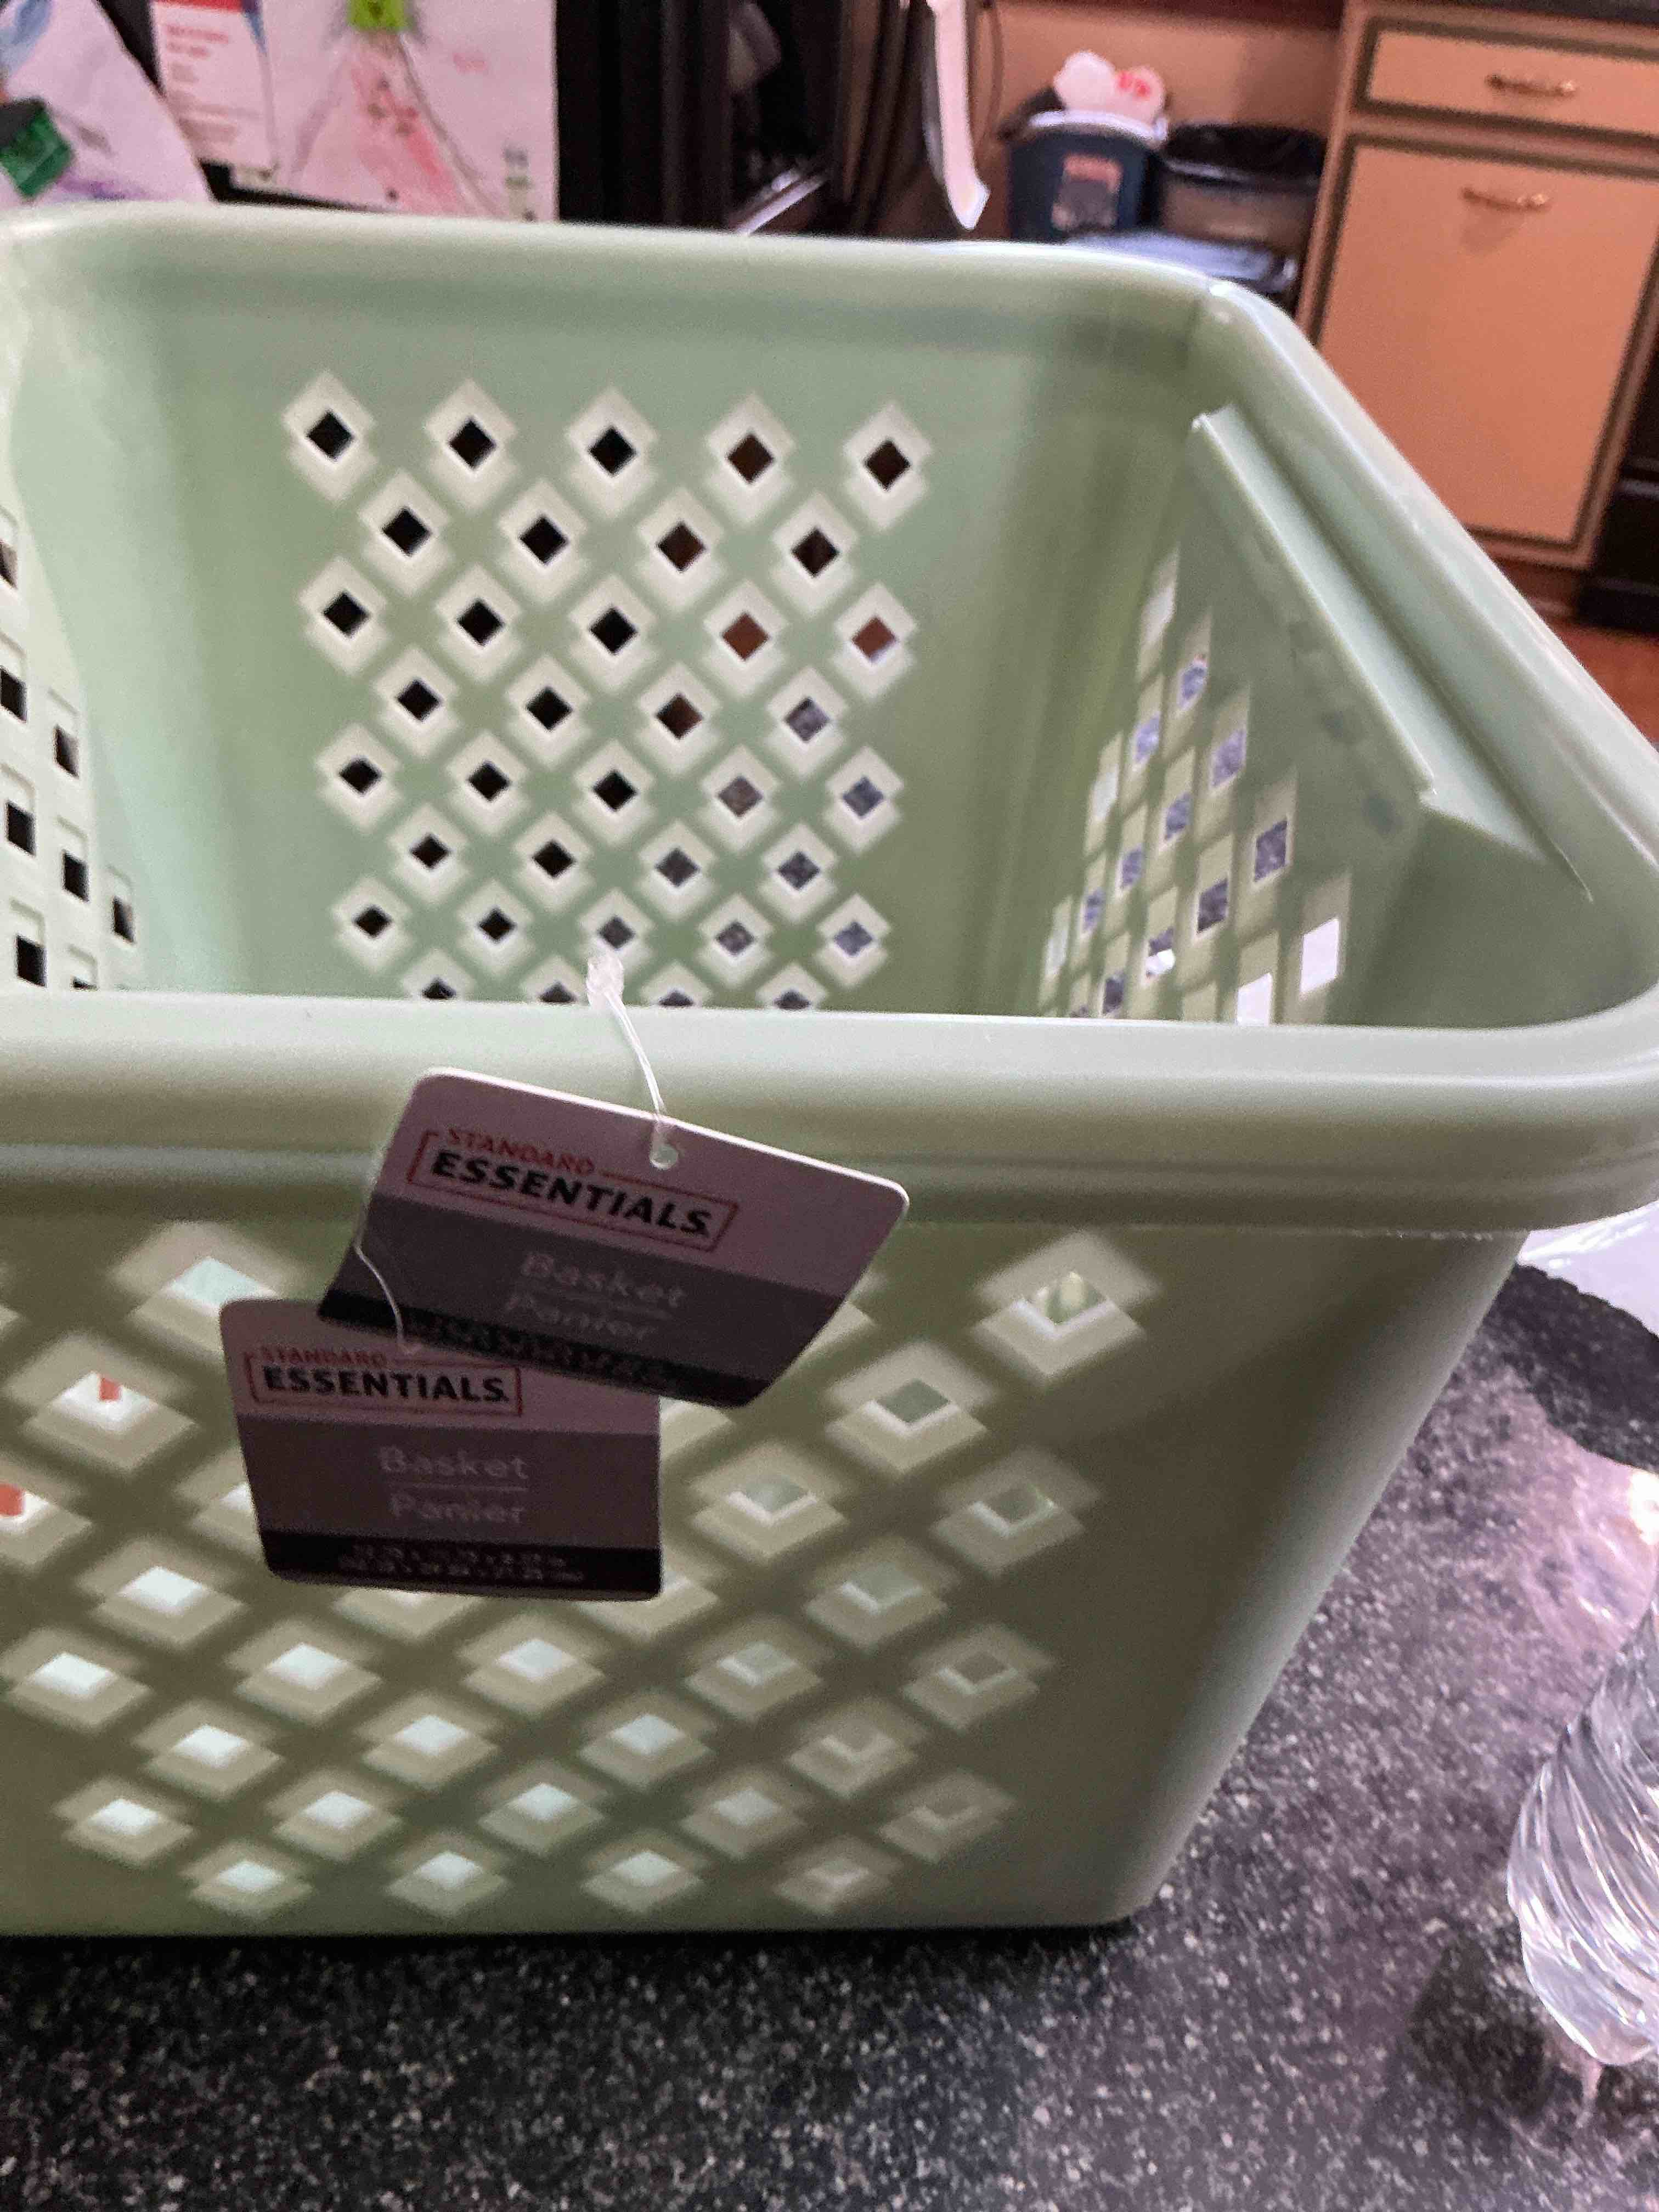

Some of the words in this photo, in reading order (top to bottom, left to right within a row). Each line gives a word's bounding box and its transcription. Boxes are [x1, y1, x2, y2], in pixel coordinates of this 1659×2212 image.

[447, 1127, 595, 1176] STANDARD
[431, 1148, 712, 1238] ESSENTIALS
[521, 1251, 687, 1309] Basket
[259, 1345, 387, 1367] STANDARD
[263, 1365, 510, 1403] ESSENTIALS
[378, 1444, 529, 1480] Basket
